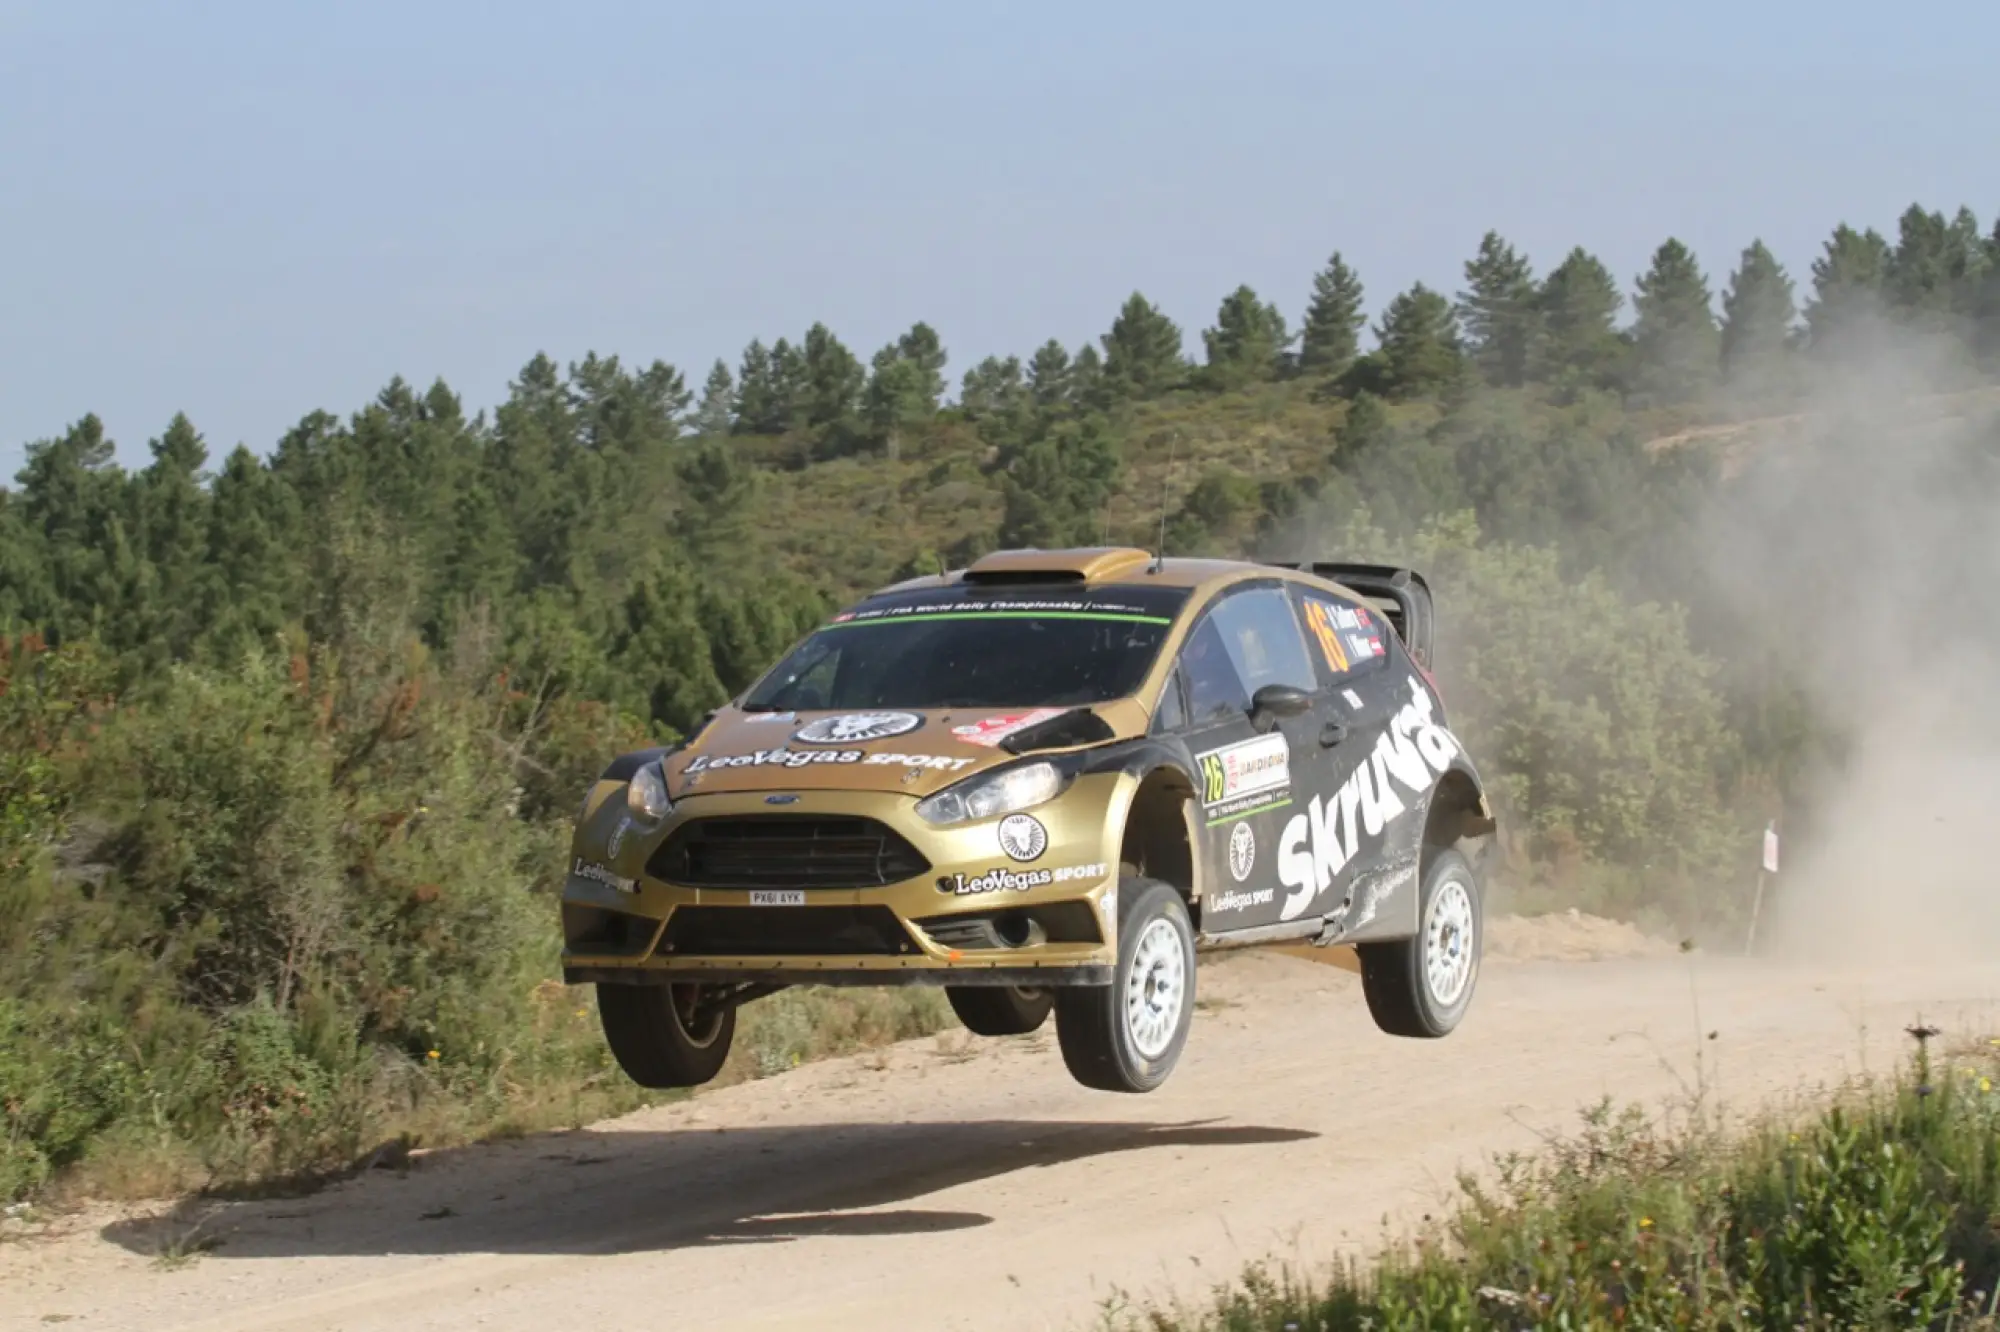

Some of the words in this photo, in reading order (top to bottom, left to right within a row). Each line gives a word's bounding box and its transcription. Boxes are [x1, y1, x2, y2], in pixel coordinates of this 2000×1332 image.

[1303, 601, 1349, 672] 16
[680, 747, 863, 774] LeoVegas
[863, 752, 976, 770] SPORT
[1203, 754, 1223, 802] 16
[954, 867, 1053, 895] LeoVegas
[1053, 863, 1107, 882] SPORT
[754, 892, 777, 904] PX61
[780, 892, 801, 904] AYK
[1210, 890, 1252, 912] LeoVegas
